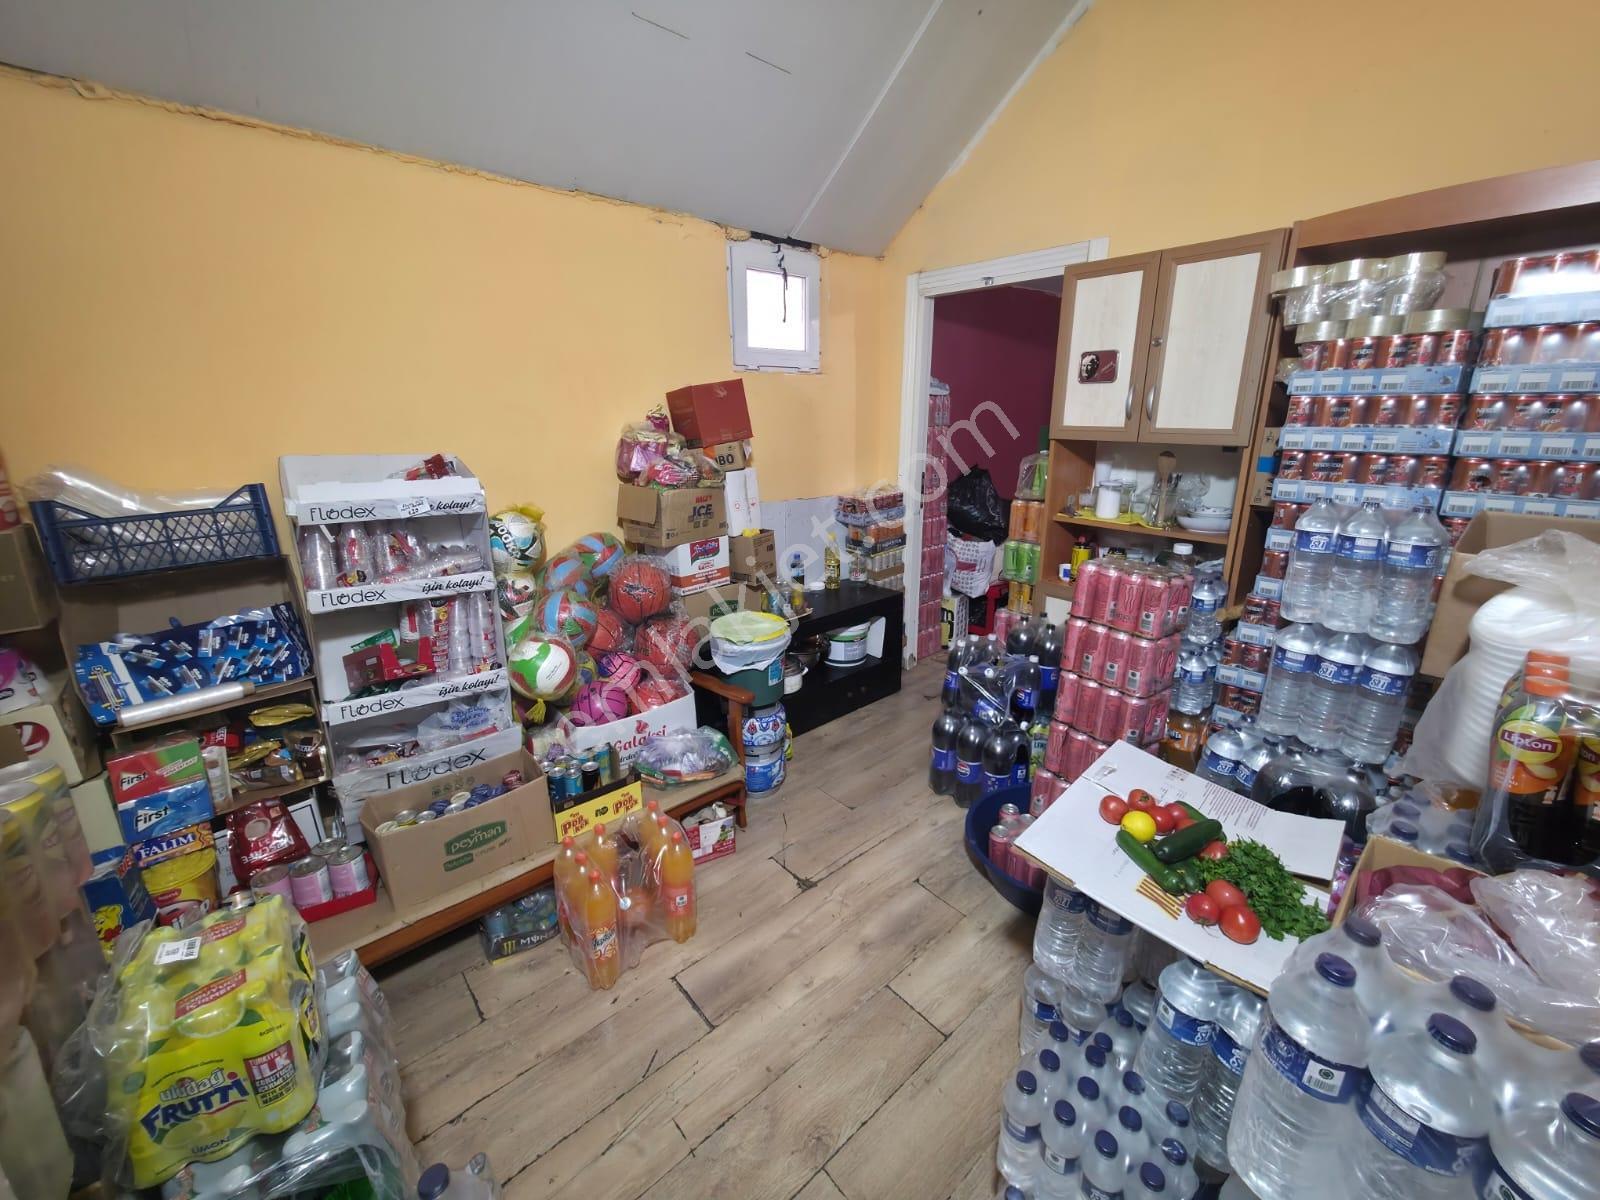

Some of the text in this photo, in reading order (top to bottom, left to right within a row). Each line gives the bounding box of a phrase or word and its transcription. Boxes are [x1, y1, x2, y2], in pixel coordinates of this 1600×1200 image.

[1503, 731, 1553, 751] Lipton
[119, 771, 148, 788] First
[135, 806, 170, 827] First
[140, 833, 195, 858] FALIM
[451, 826, 502, 853] peyman
